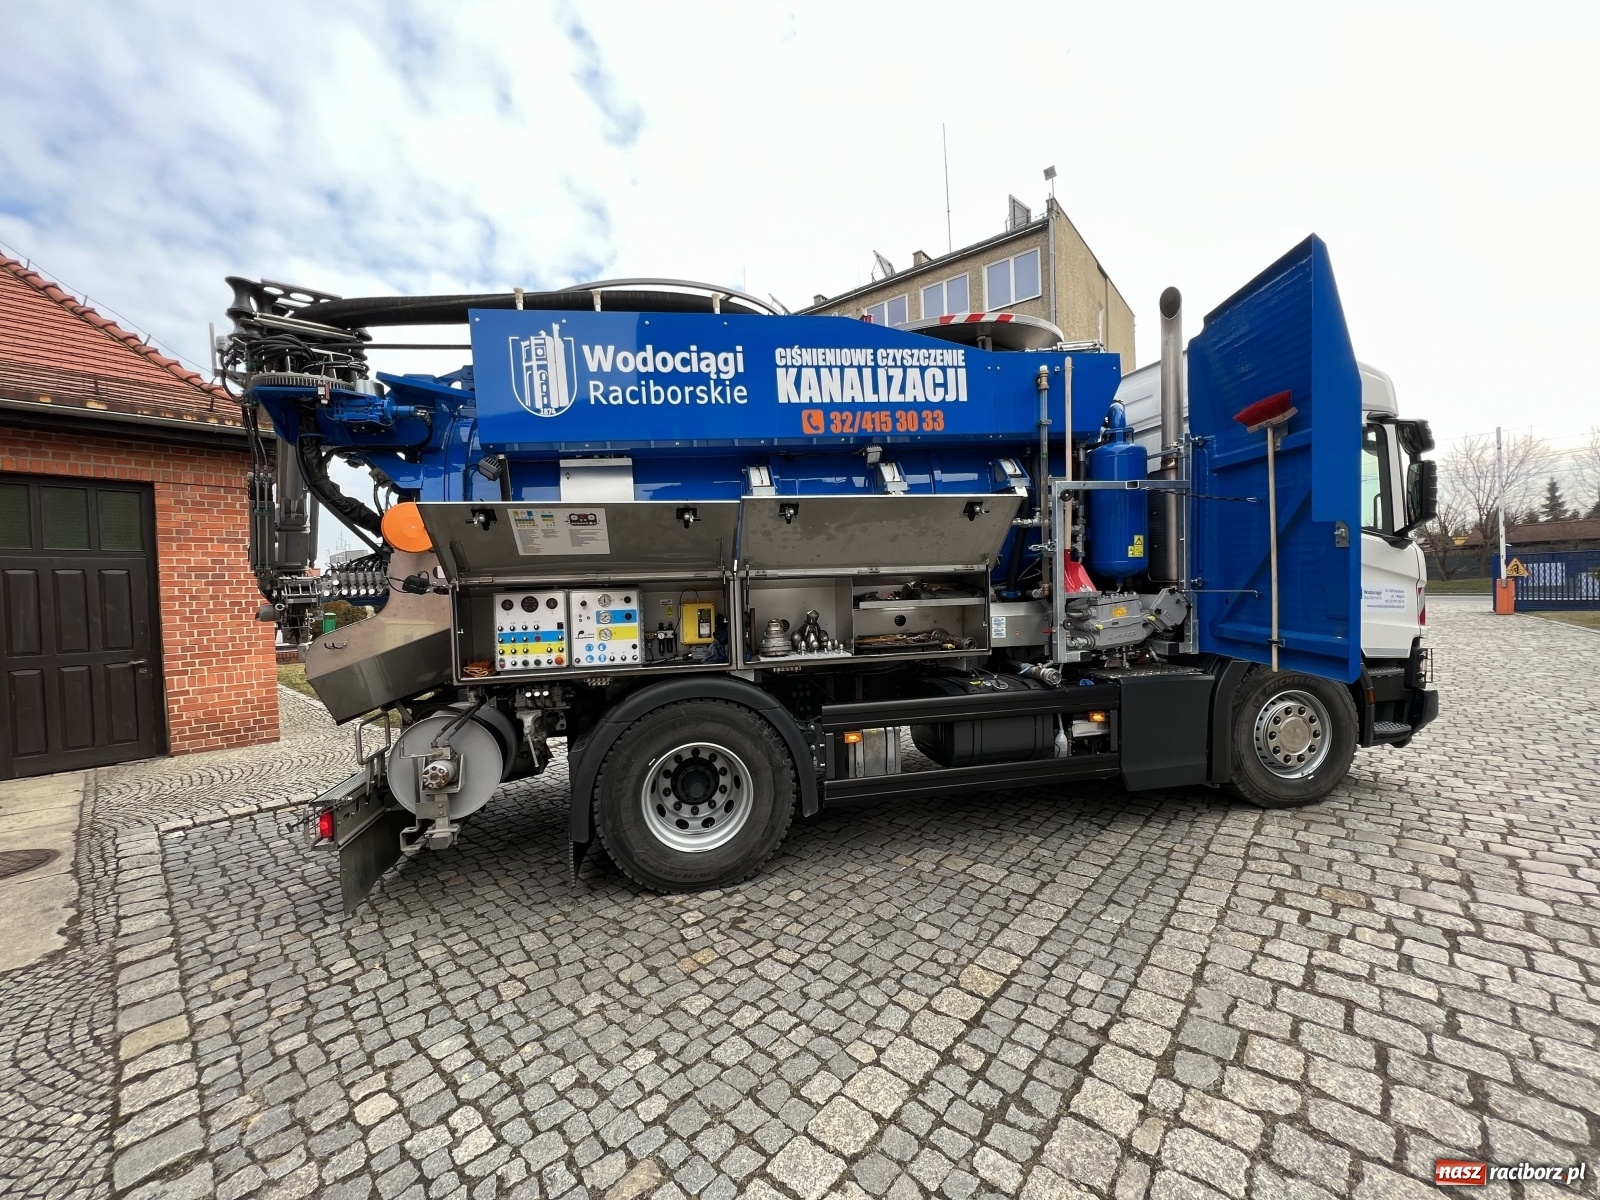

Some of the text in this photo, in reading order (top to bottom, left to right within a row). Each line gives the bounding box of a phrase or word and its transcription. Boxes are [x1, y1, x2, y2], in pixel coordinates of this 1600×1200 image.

[582, 345, 744, 379] Wodociągi
[775, 345, 965, 366] CIŚNIENIOWE CZYSZCZENIE
[589, 380, 748, 405] Raciborskie
[776, 367, 968, 403] KANALIZACJI
[830, 410, 944, 433] 32/415 30 33
